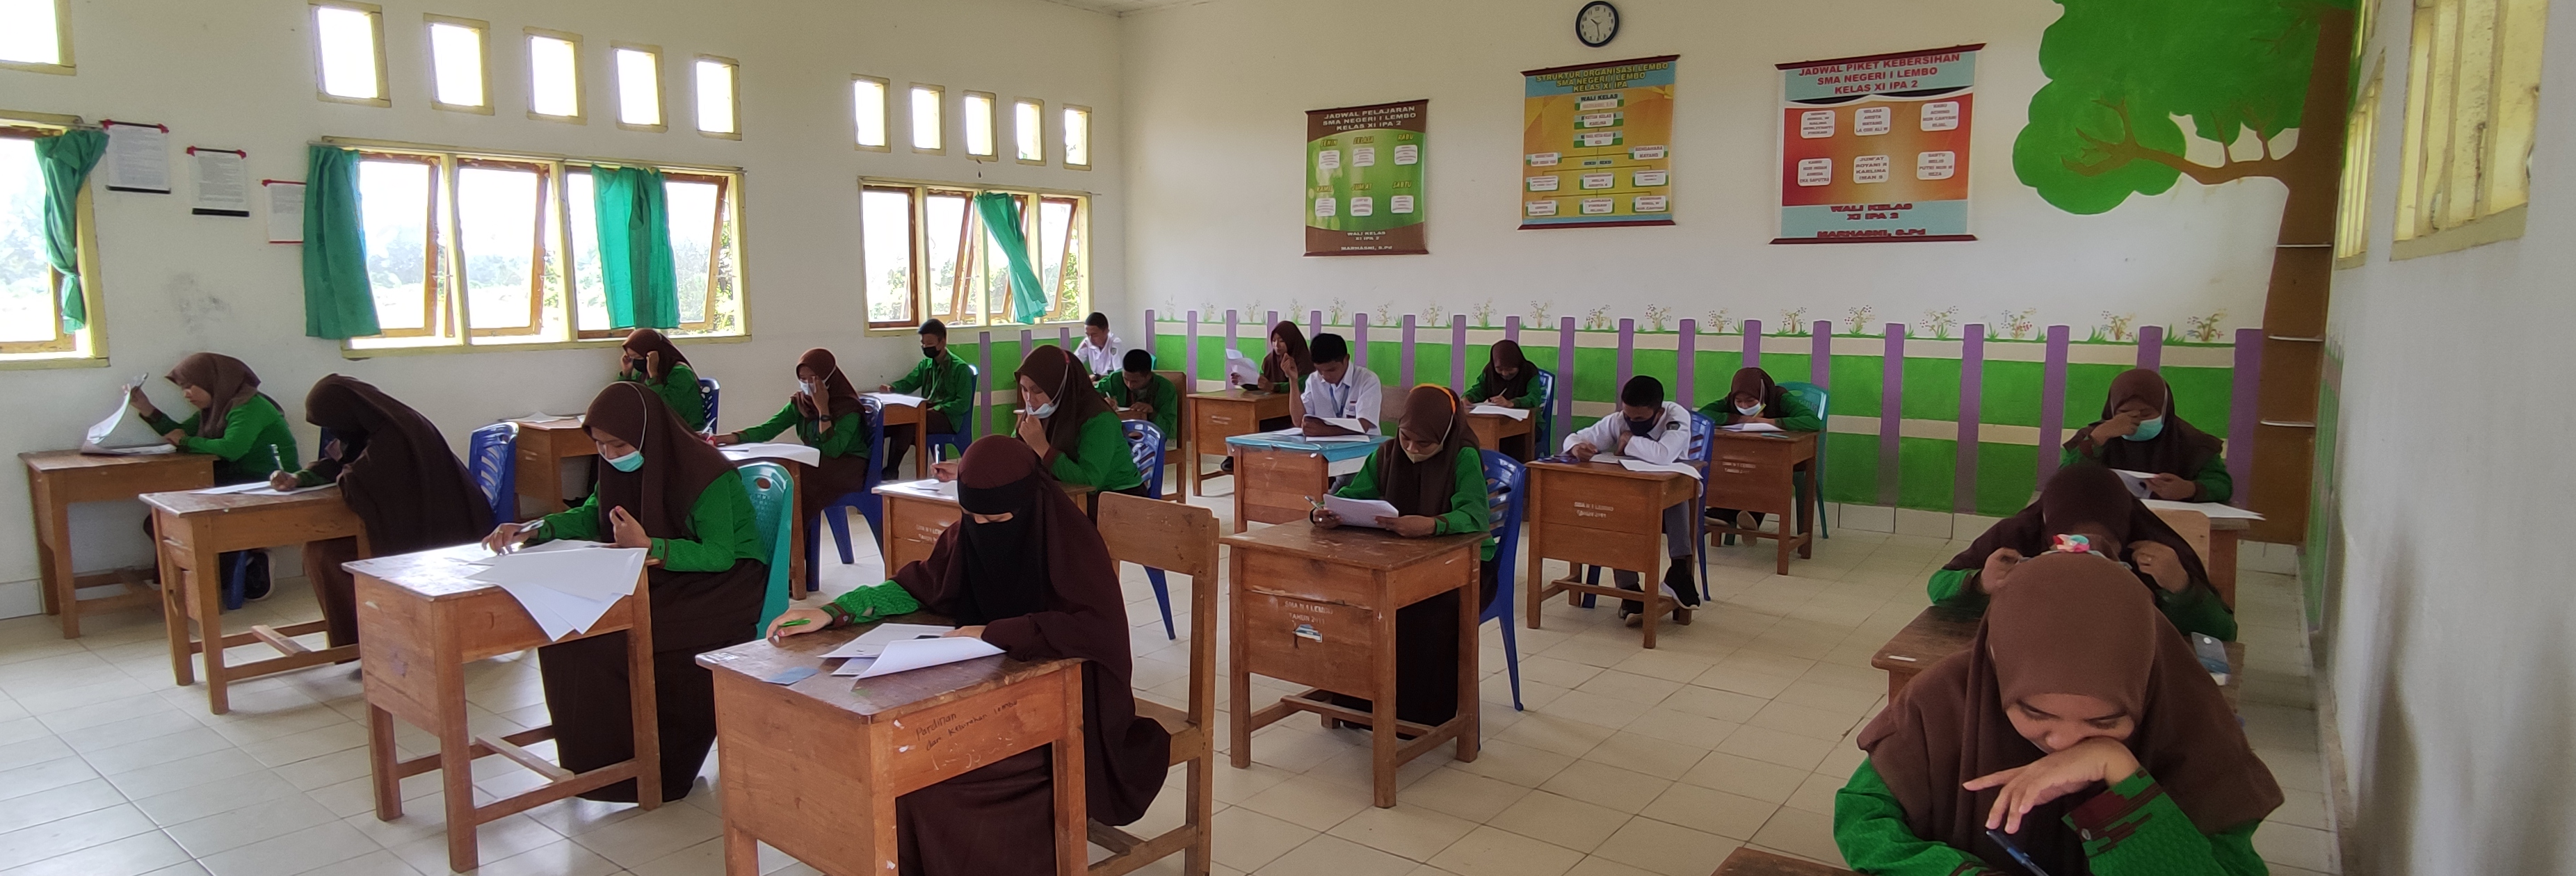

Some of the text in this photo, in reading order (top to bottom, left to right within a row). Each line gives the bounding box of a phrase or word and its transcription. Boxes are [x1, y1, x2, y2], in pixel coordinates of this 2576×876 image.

[1536, 63, 1668, 82] STRUKTUR ORGANISASI LEMBO
[1798, 54, 1961, 76] JADWAL PIKET KEBERSIHAN
[1577, 76, 1608, 85] NEGERI
[1616, 72, 1646, 81] LEMBO
[1817, 76, 1841, 86] SMA
[1844, 72, 1886, 83] NEGERI
[1897, 67, 1938, 79] LEMBO
[1572, 84, 1600, 92] KELAS
[1835, 80, 1918, 95] KELAS XI IPA 2
[1362, 106, 1415, 115] PELAJARAN
